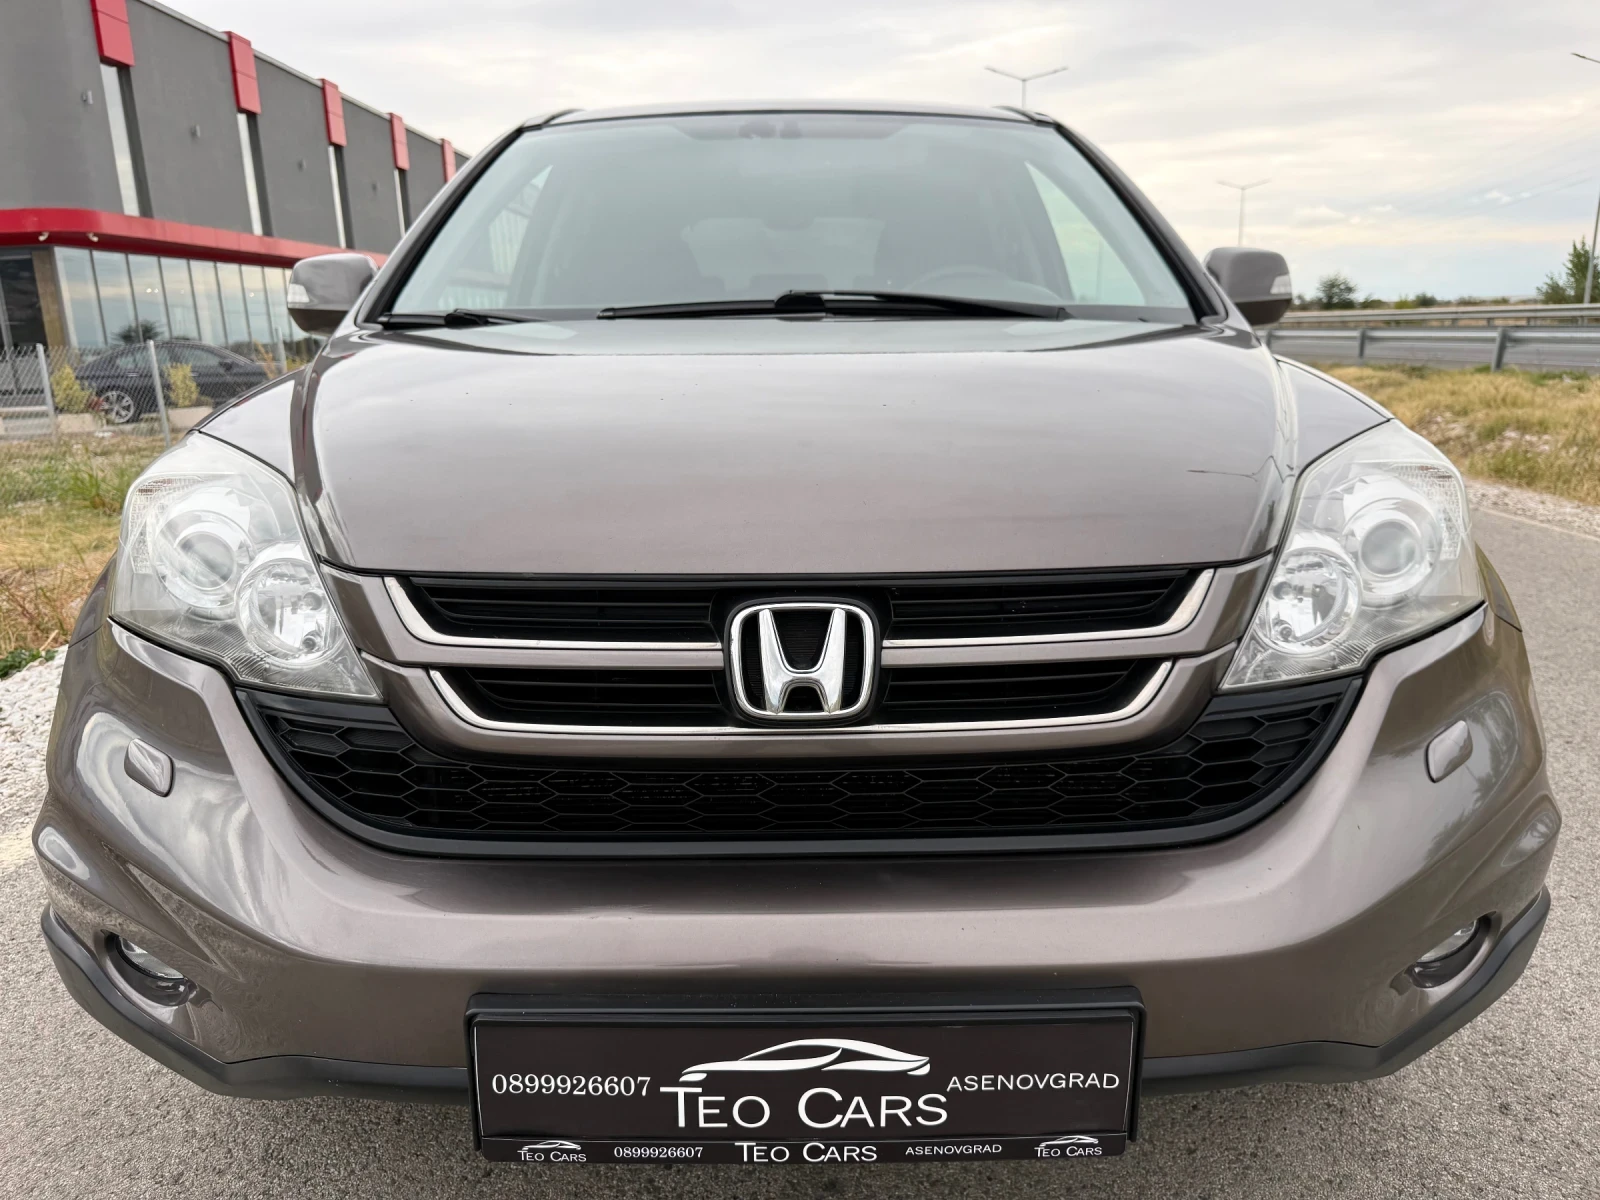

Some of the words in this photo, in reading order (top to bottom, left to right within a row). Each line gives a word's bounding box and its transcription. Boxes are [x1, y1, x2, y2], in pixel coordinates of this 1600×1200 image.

[492, 1073, 651, 1096] 0899926607
[948, 1073, 1120, 1091] ASENOVGRAD
[660, 1086, 770, 1128] TEO
[798, 1087, 948, 1128] CARS
[613, 1146, 703, 1158] 0899926607
[735, 1142, 793, 1162] TEO
[803, 1141, 878, 1162] CARS
[905, 1144, 1002, 1155] ASENOVGRAD
